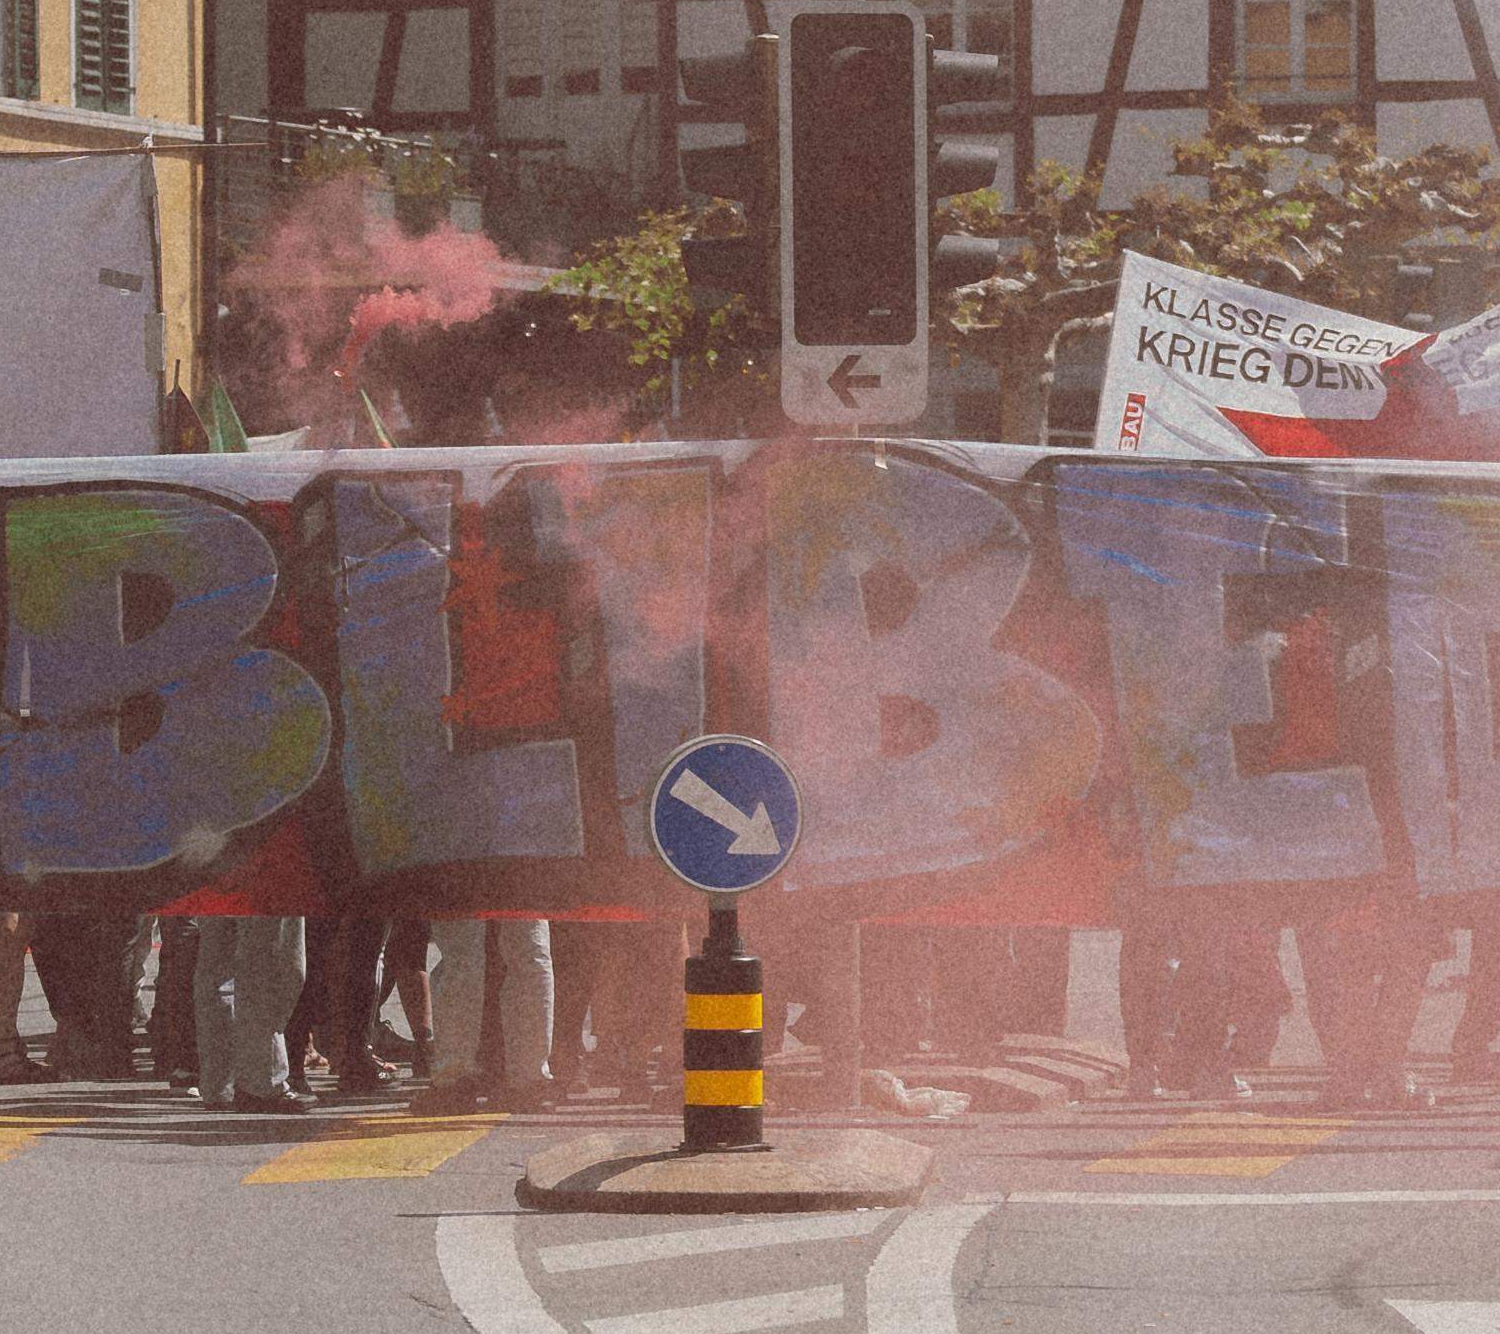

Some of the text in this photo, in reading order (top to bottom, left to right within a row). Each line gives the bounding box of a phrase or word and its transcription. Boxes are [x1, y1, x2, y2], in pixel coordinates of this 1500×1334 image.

[1142, 281, 1287, 343] KLASSE
[1288, 321, 1406, 360] GEGEN
[1135, 325, 1273, 385] KRIEG
[1283, 351, 1376, 391] DEM
